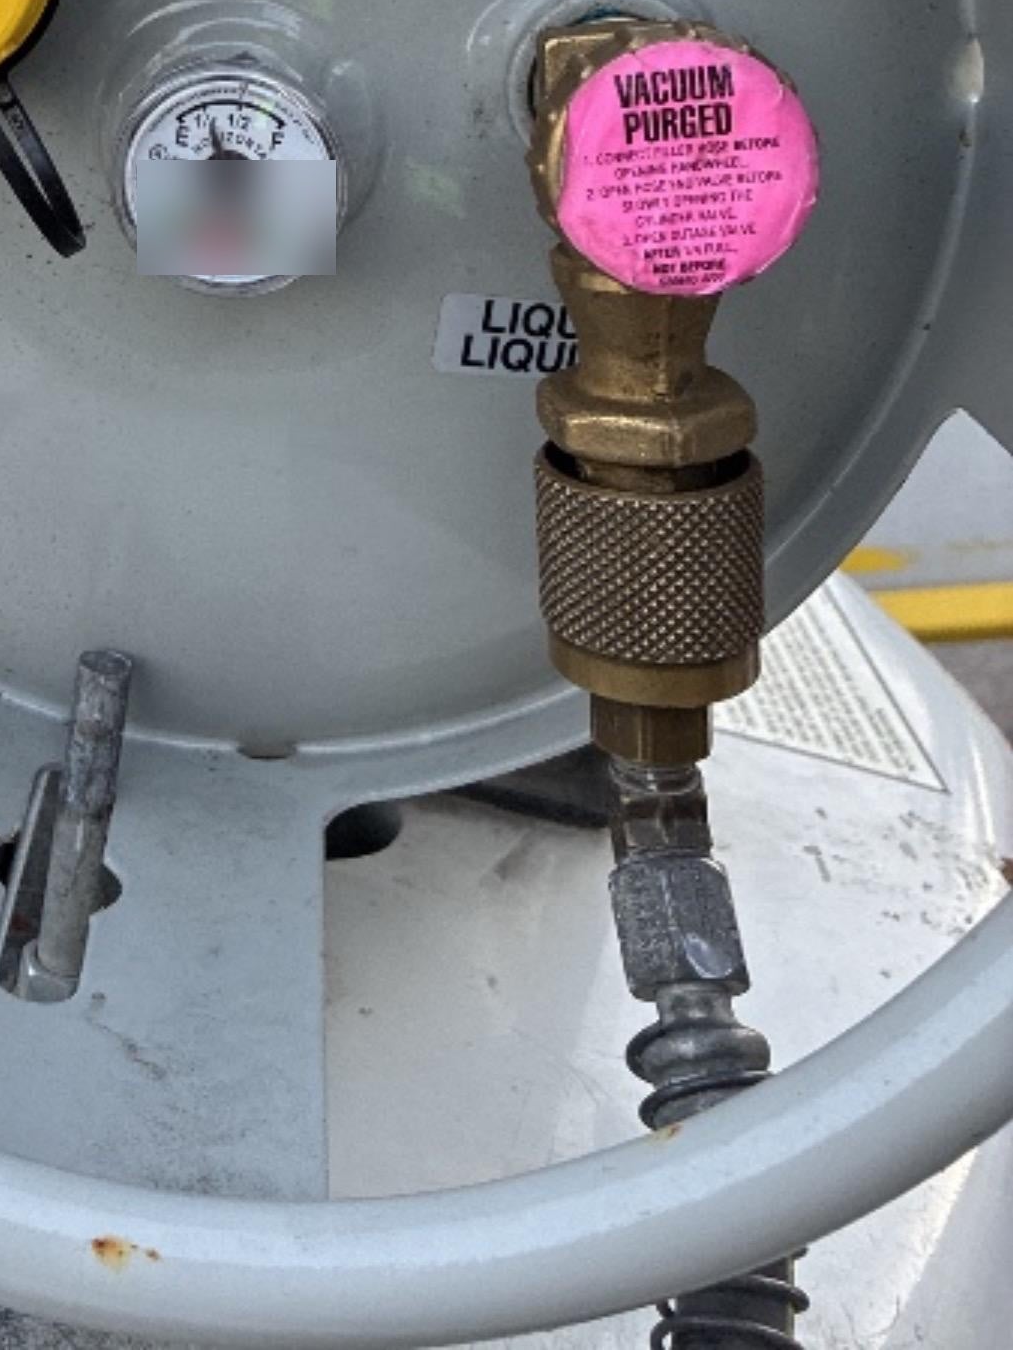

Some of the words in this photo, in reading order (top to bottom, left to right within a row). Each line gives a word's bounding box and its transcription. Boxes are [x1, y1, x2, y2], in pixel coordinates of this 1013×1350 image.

[614, 63, 735, 108] VACUUM
[175, 125, 190, 148] E
[228, 113, 251, 131] 1/2
[271, 131, 285, 150] F
[623, 103, 732, 144] PURGED
[482, 299, 577, 339] LIQU
[460, 335, 577, 372] LIQUI
